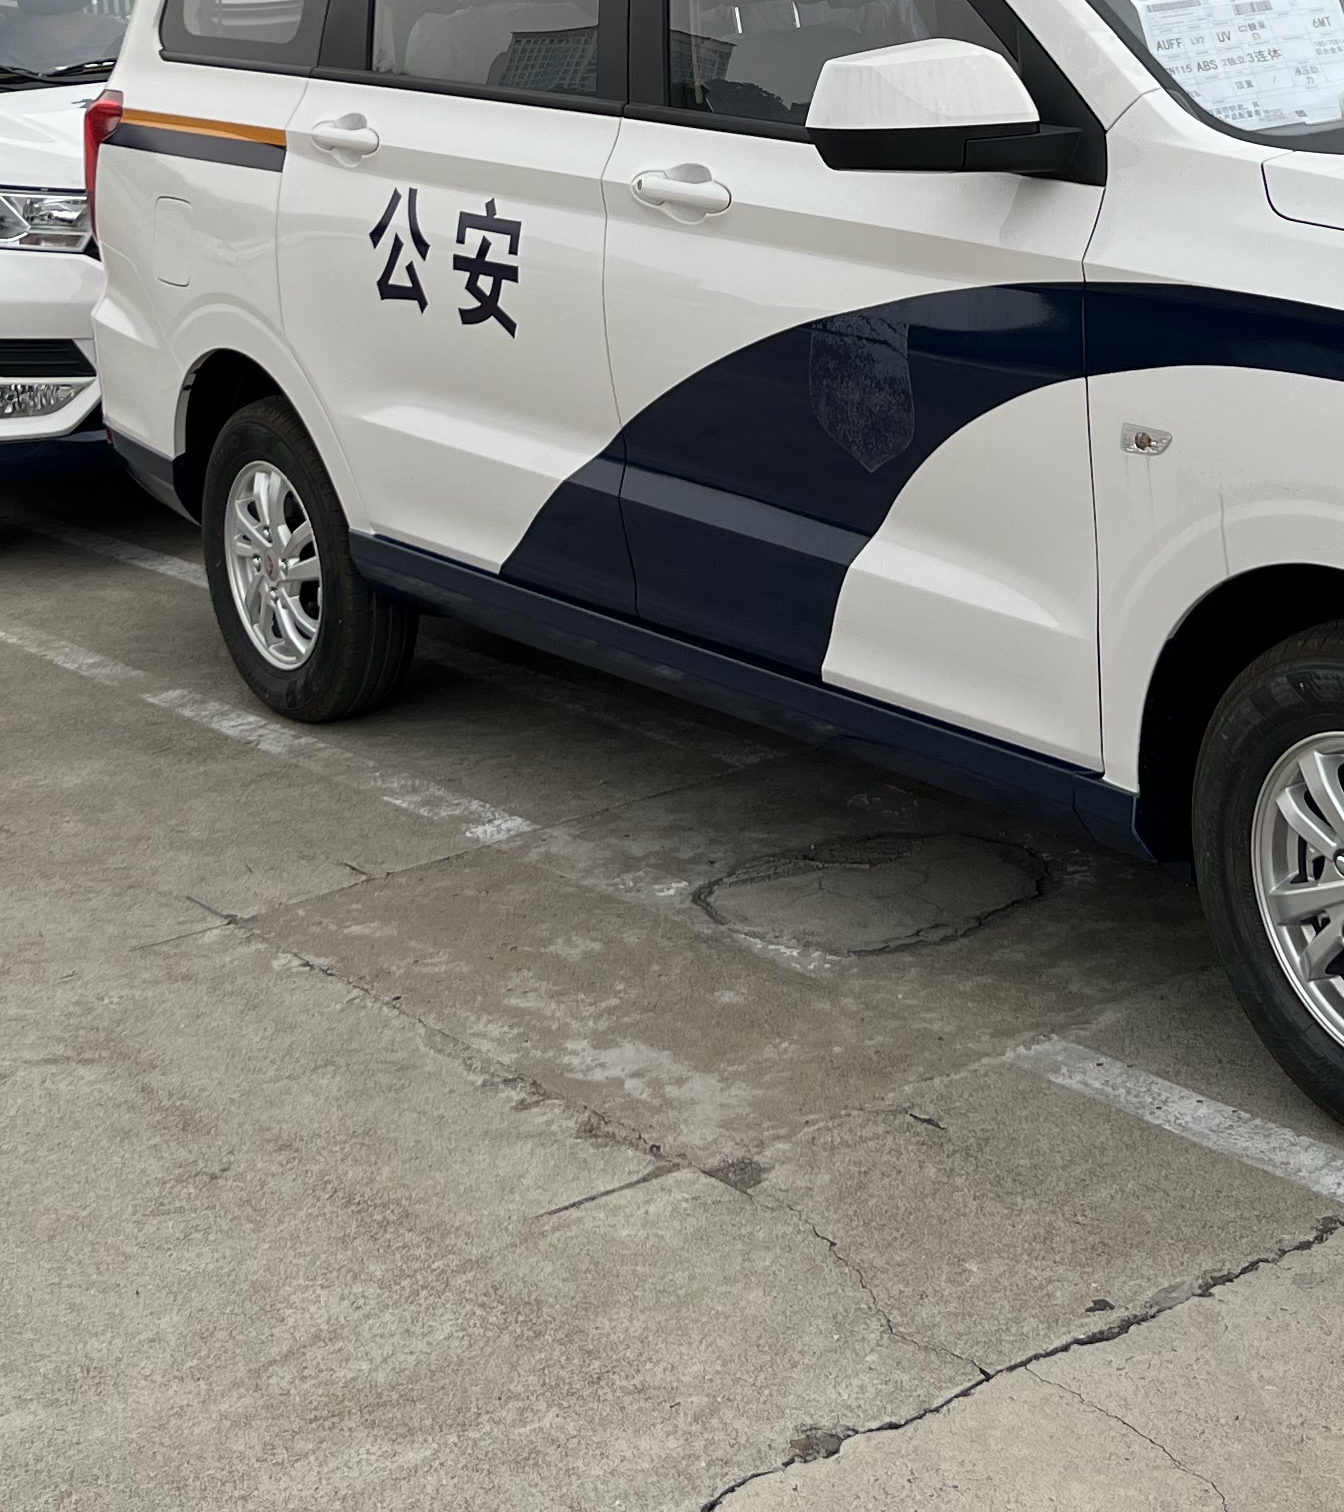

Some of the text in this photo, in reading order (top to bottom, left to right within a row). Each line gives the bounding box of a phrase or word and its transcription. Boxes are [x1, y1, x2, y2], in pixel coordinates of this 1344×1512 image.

[1312, 16, 1332, 29] 6MT
[1215, 30, 1231, 44] UV
[1156, 37, 1183, 52] AUFF
[1196, 59, 1219, 73] ABS
[368, 186, 523, 339] 公安
